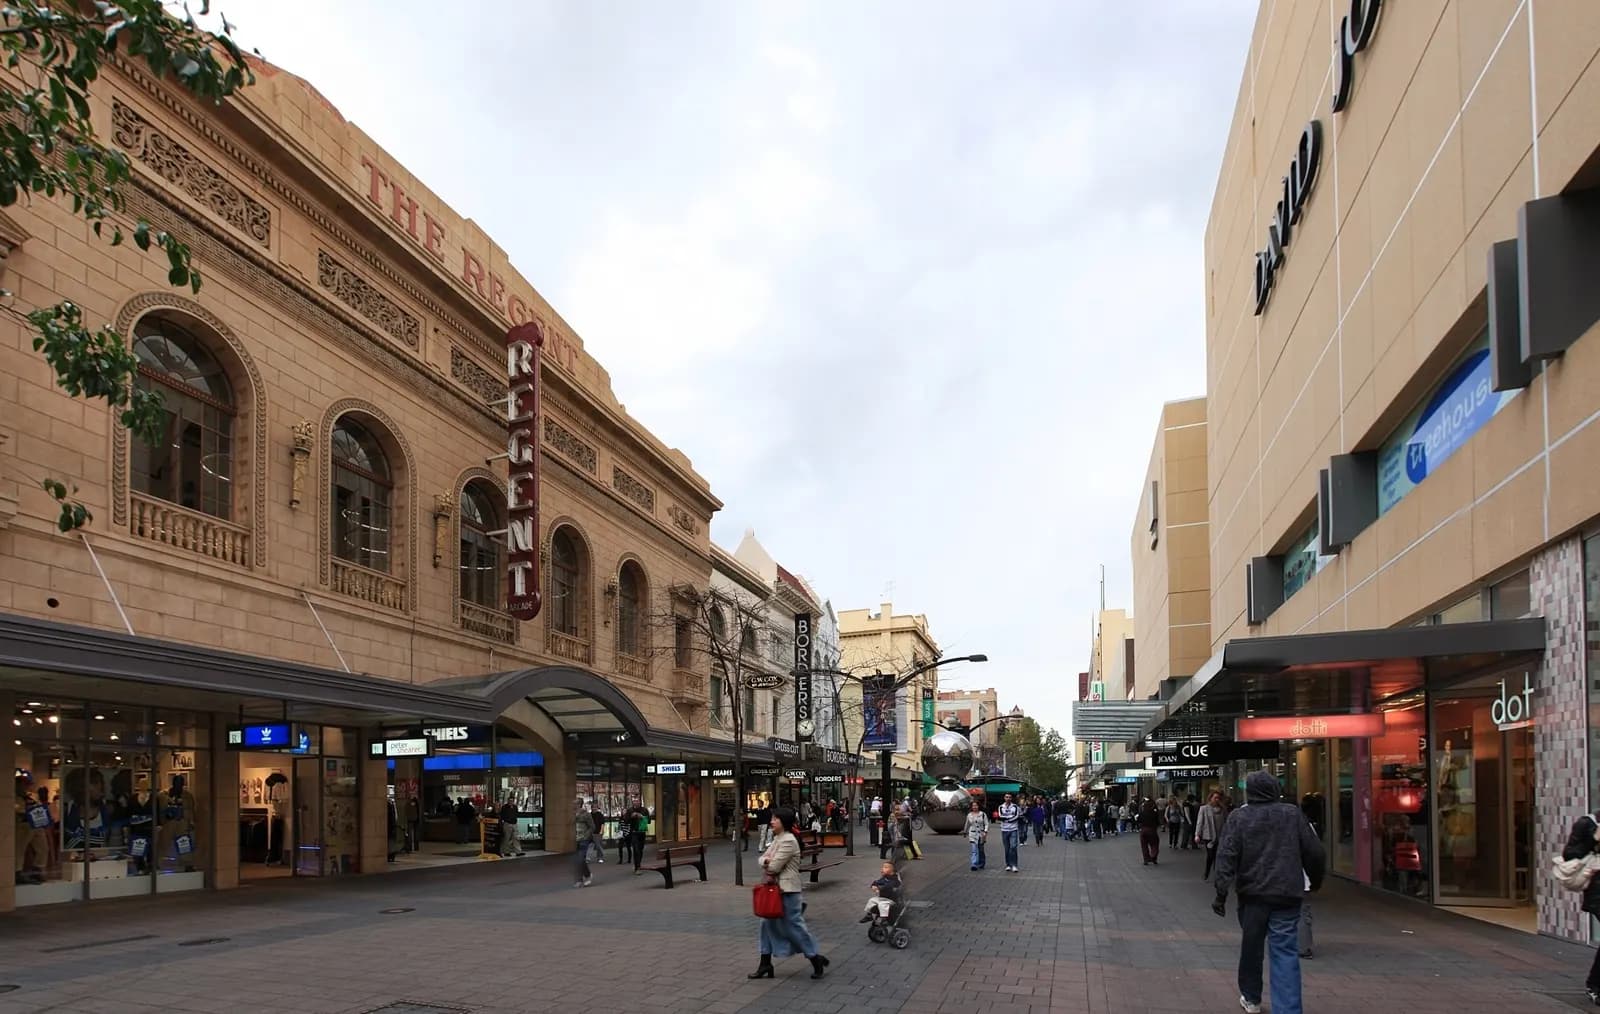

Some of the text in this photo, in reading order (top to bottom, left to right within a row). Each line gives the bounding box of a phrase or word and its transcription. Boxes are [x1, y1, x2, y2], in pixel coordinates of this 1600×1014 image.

[361, 154, 446, 263] THE
[1254, 119, 1323, 316] DAVID
[506, 340, 535, 597] REGENT
[422, 726, 469, 741] SHIELS
[1181, 744, 1209, 758] CUE
[1190, 769, 1215, 777] BODY
